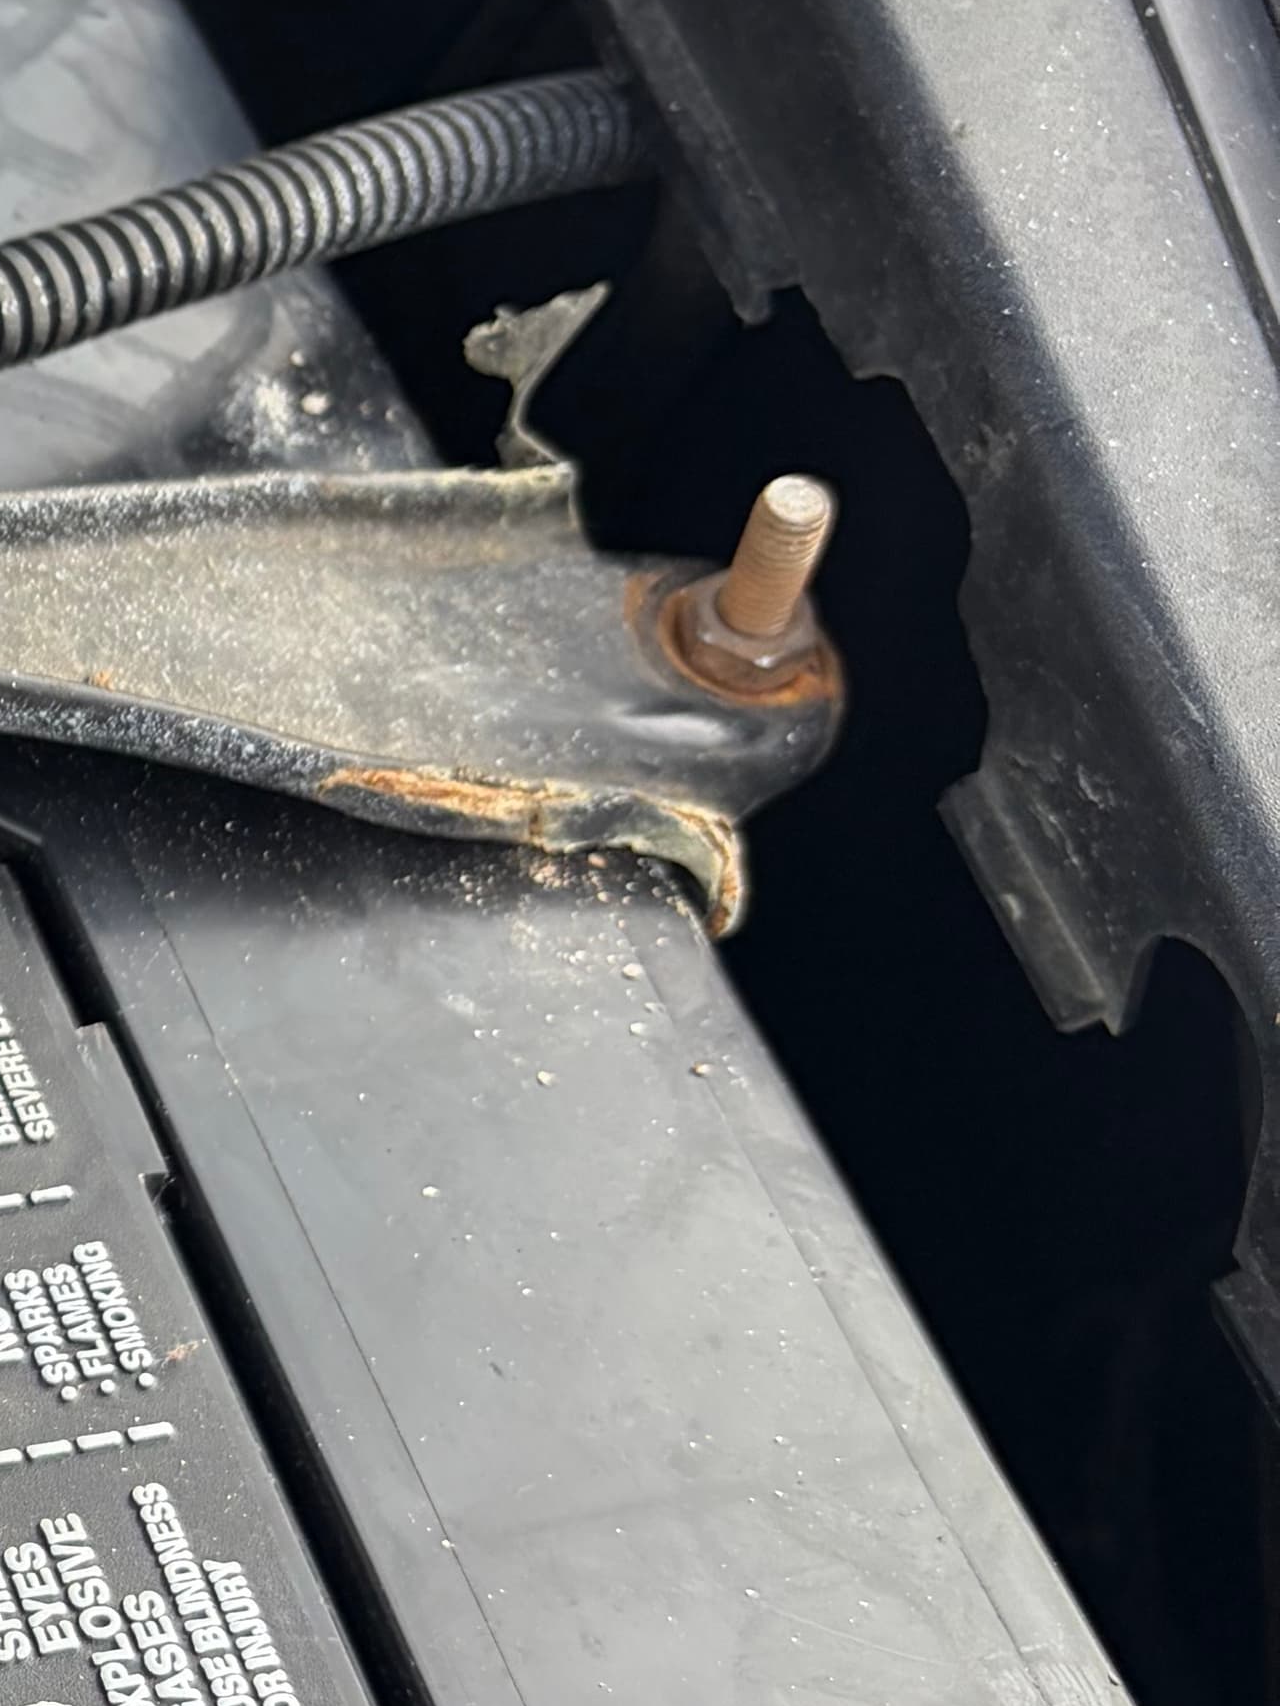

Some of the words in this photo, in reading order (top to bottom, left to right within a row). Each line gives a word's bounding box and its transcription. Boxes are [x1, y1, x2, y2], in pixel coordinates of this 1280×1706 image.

[3, 1542, 83, 1654] EYES
[132, 1482, 232, 1653] BLINDNESS
[202, 1559, 282, 1670] INJURY
